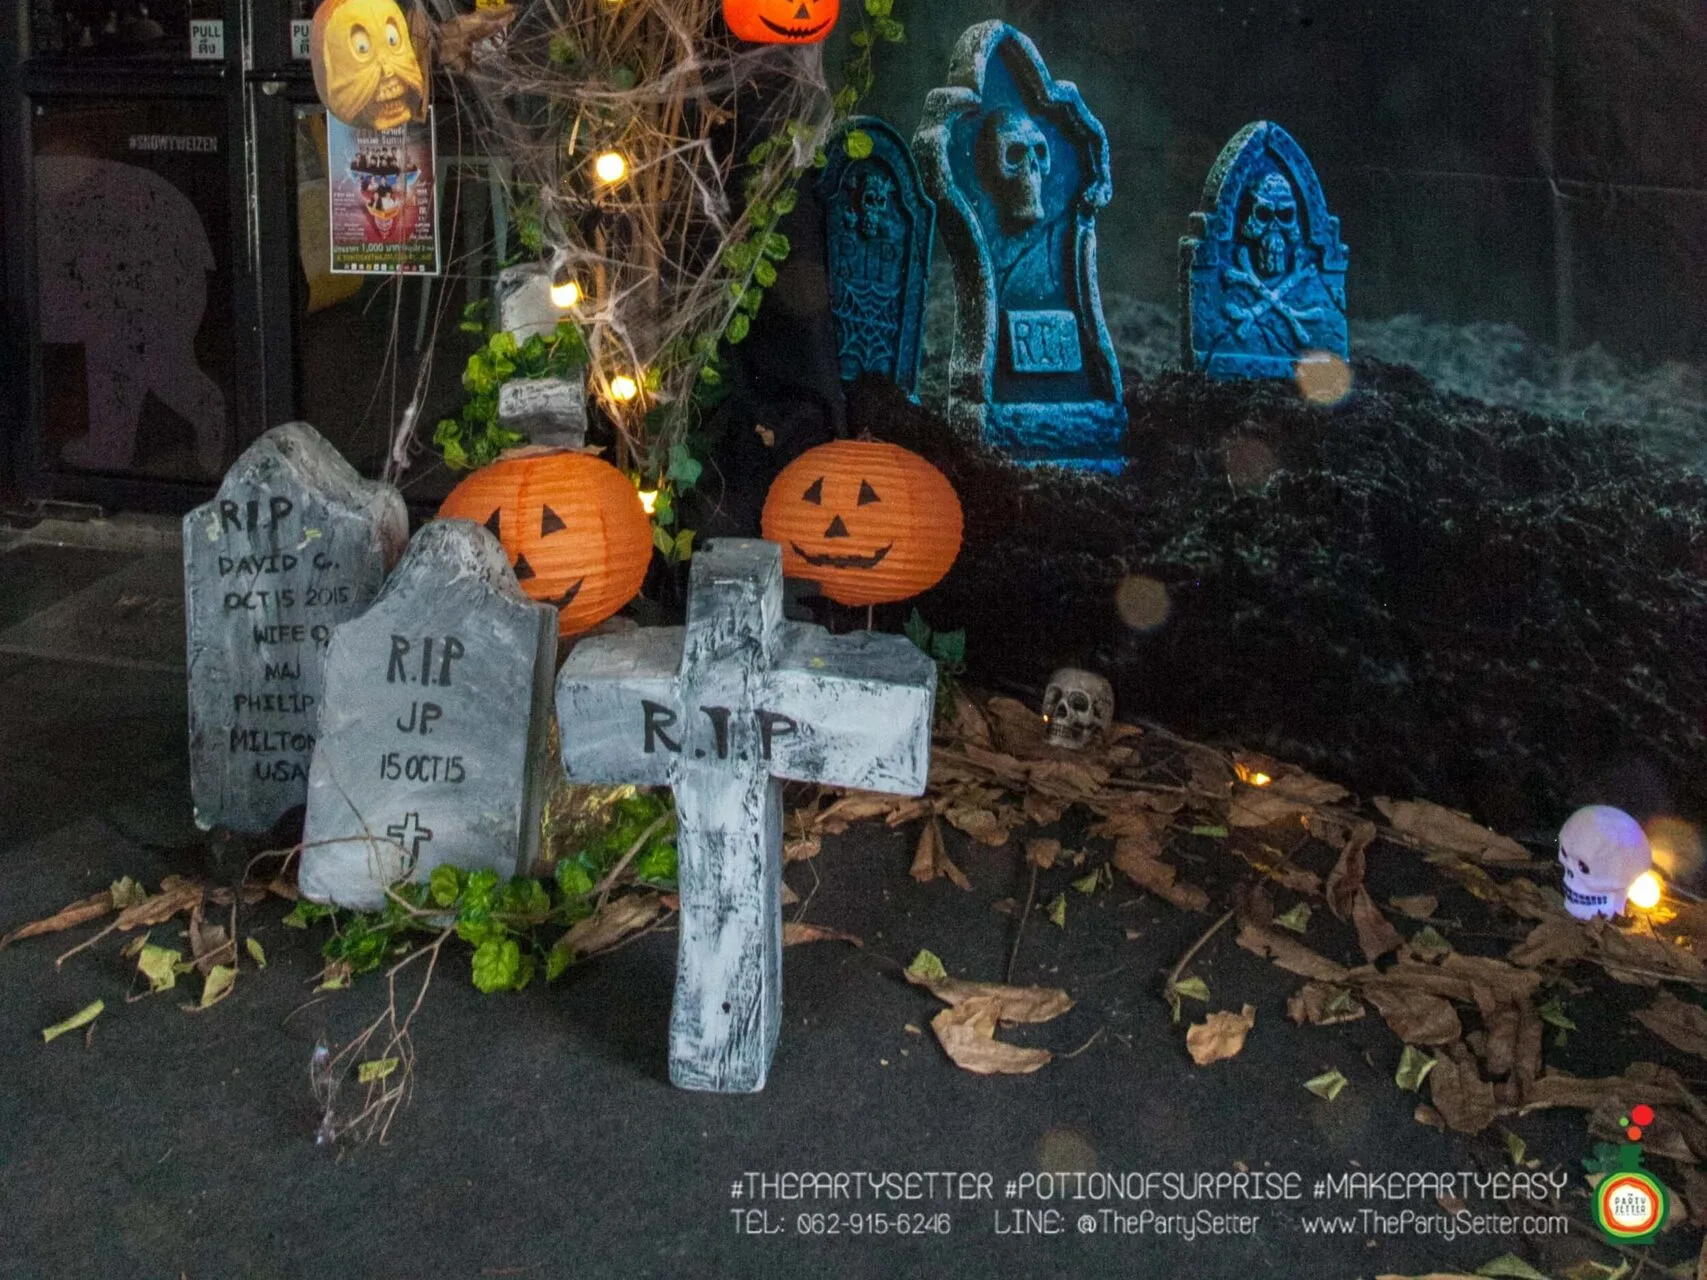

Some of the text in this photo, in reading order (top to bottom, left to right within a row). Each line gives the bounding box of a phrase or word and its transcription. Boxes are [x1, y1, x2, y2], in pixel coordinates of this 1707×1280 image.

[192, 25, 221, 38] PULL
[293, 24, 310, 37] PU
[129, 134, 218, 152] #SNOWYWEIZEN
[218, 553, 298, 579] DAVID
[305, 586, 349, 607] 2015
[253, 624, 305, 646] WIFE
[265, 662, 301, 681] MAJ
[234, 694, 315, 713] PHILIP
